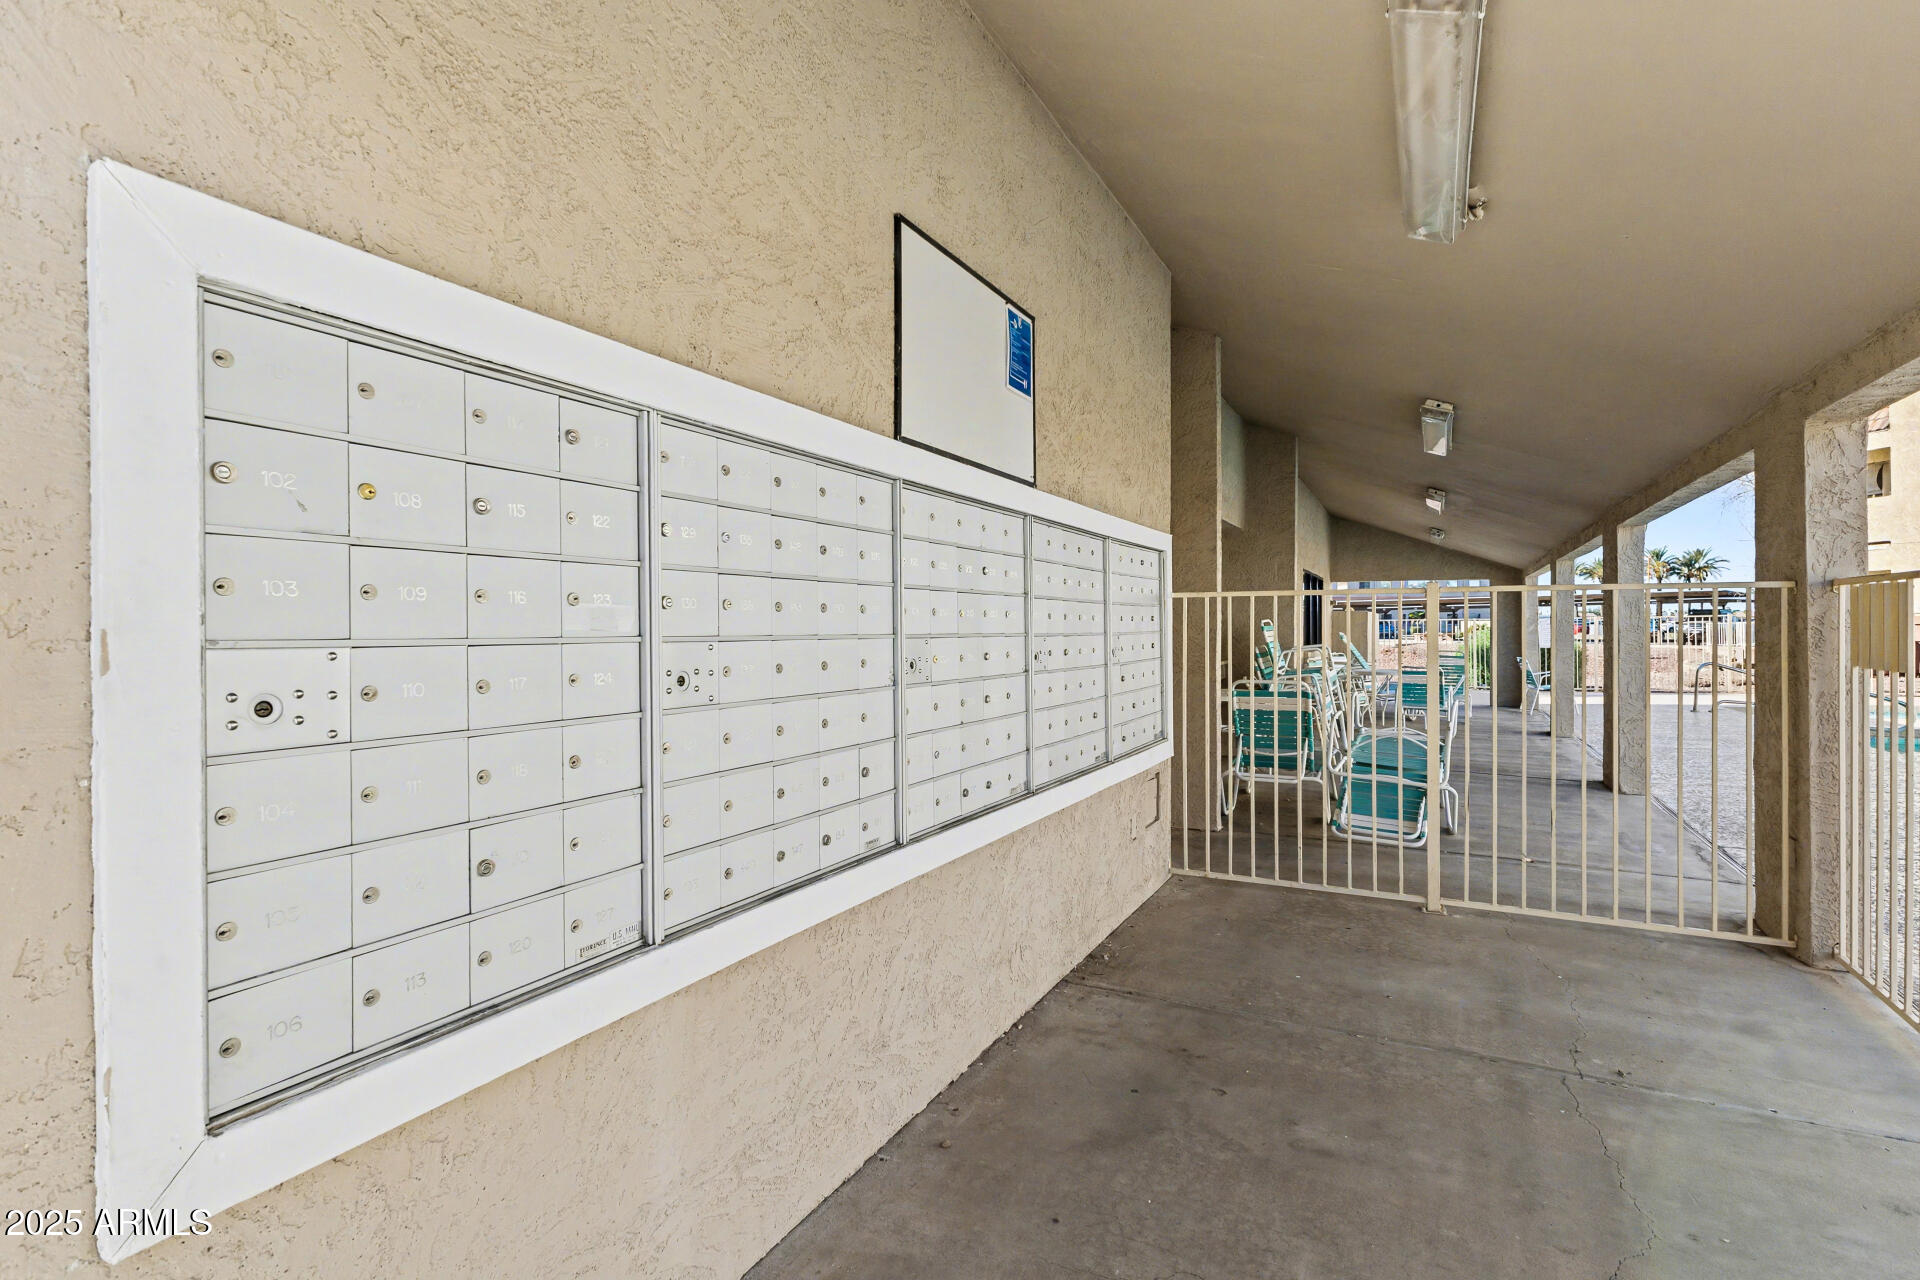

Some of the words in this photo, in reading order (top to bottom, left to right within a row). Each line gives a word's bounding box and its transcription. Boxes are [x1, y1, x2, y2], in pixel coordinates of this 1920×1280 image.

[262, 471, 297, 490] 102
[394, 492, 422, 508] 108
[507, 503, 527, 517] 115
[592, 514, 610, 528] 122
[262, 580, 299, 597] 103
[399, 586, 427, 601] 109
[508, 591, 527, 605] 116
[592, 594, 612, 606] 123
[509, 676, 527, 691] 117
[592, 672, 613, 686] 124
[402, 683, 425, 697] 110
[257, 802, 296, 822] 104
[404, 971, 428, 992] 113
[265, 1015, 304, 1040] 106
